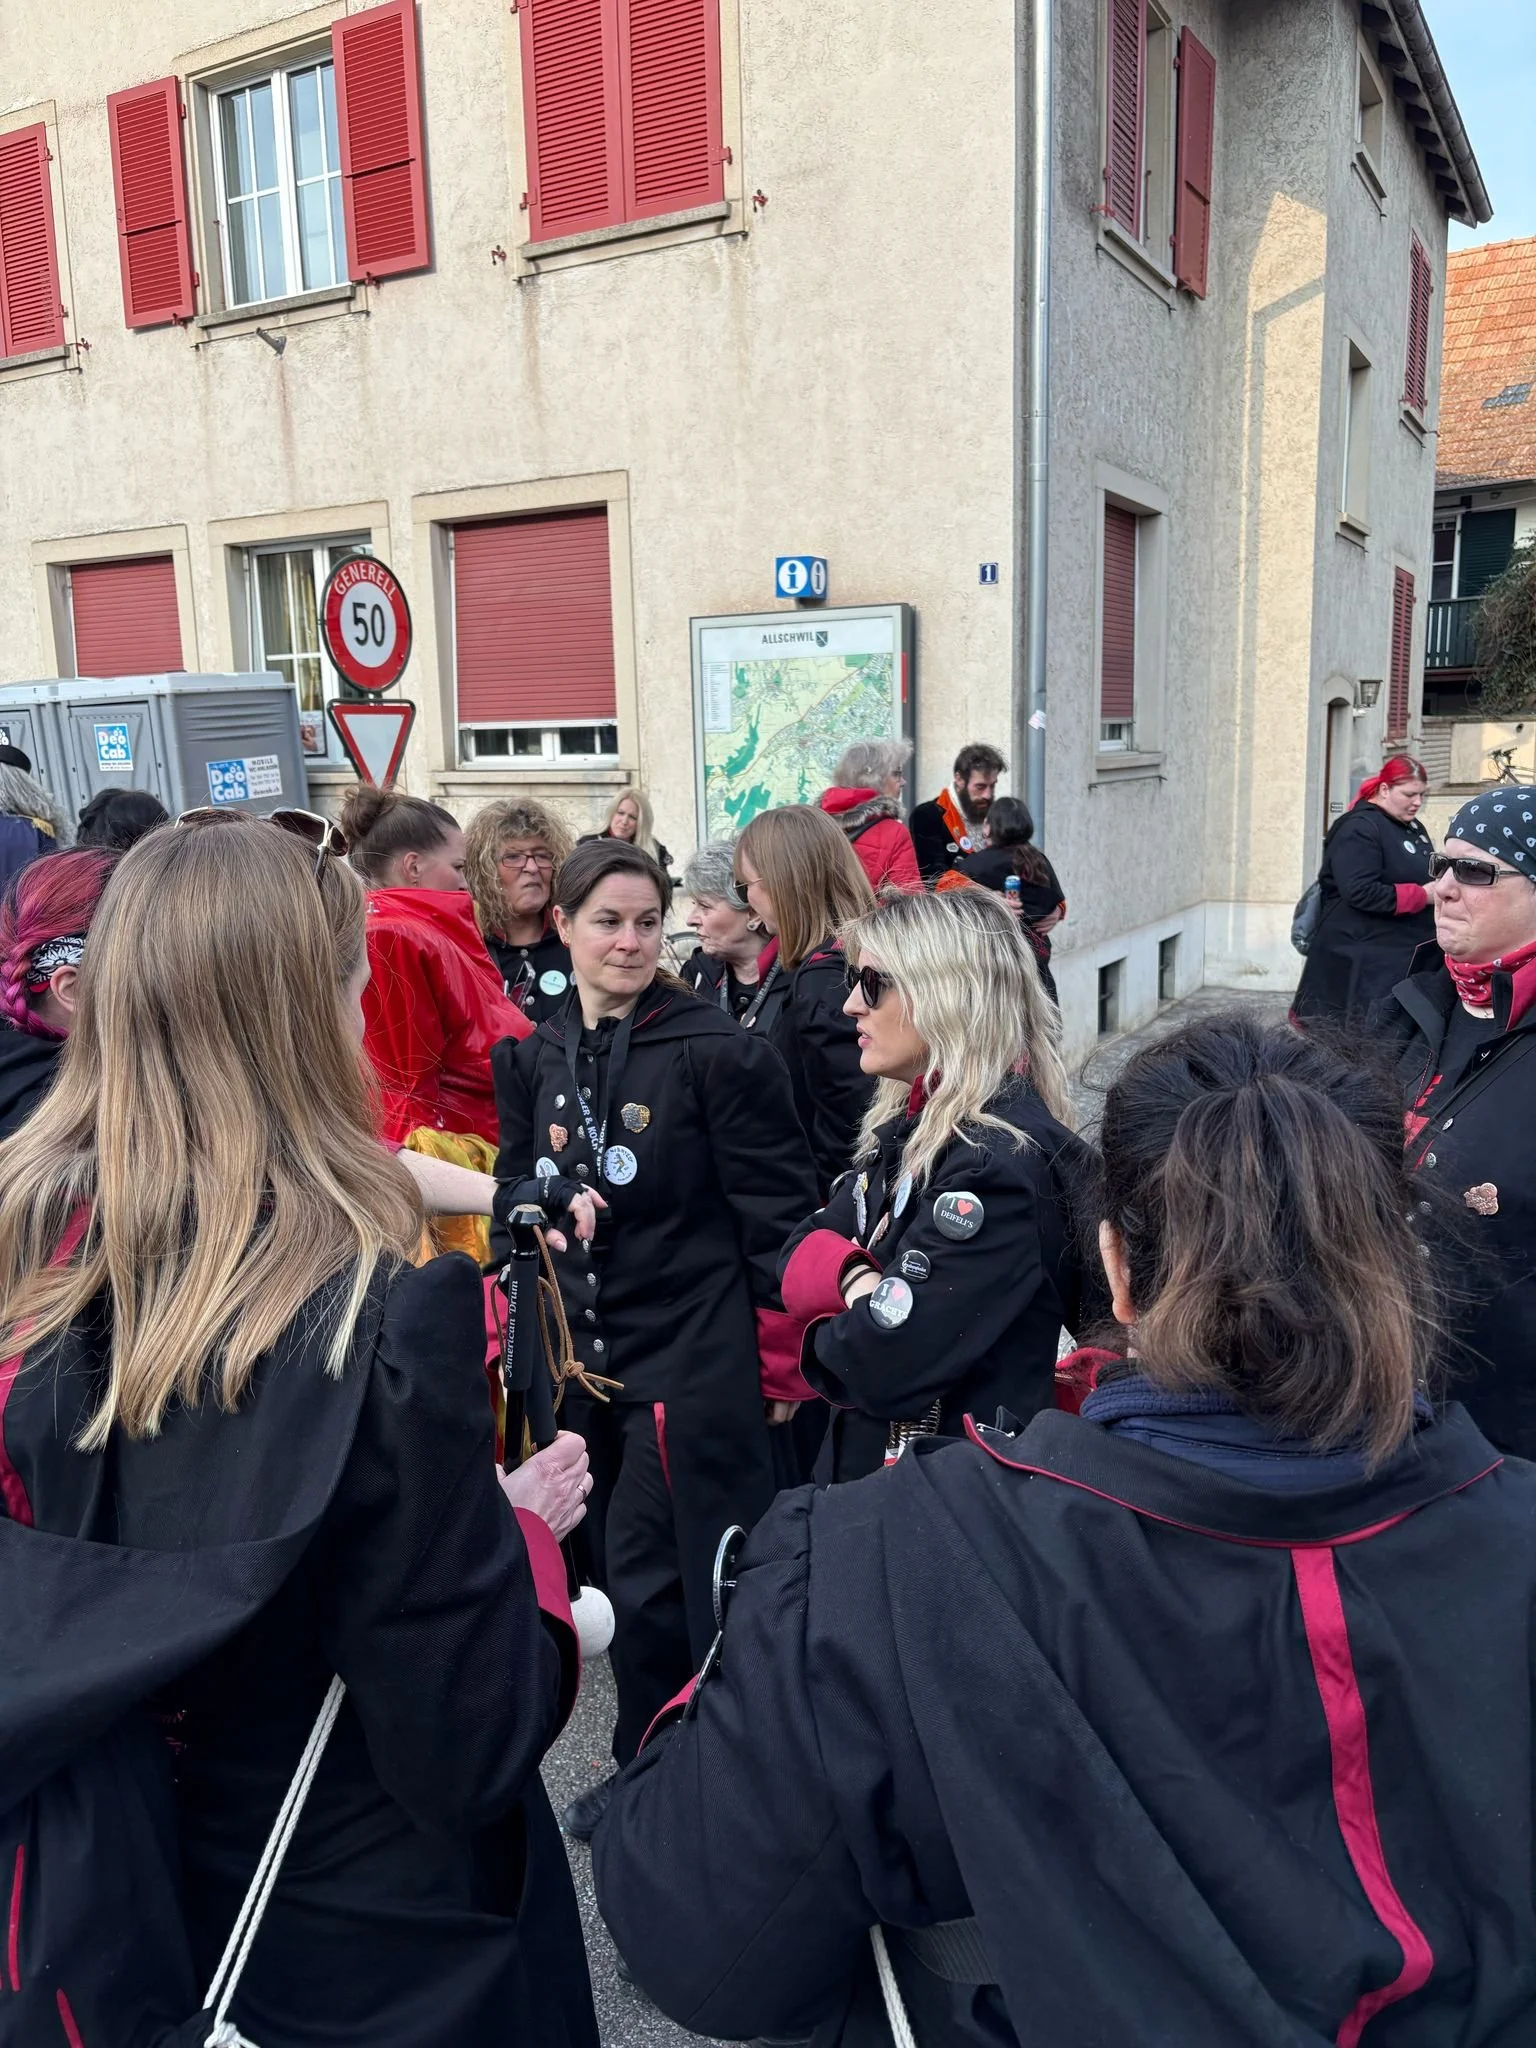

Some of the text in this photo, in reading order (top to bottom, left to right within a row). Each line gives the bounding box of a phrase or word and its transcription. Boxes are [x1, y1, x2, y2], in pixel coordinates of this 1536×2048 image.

[334, 563, 397, 600] GENERELL
[352, 602, 385, 648] 50
[762, 632, 815, 644] ALLSCHWIL
[98, 731, 126, 745] Deo
[100, 744, 126, 759] Cab
[210, 769, 246, 786] Deo
[213, 782, 246, 801] Cab
[584, 1117, 593, 1125] &
[946, 1196, 956, 1210] I
[940, 1209, 974, 1229] DEIFELI'S
[880, 1283, 888, 1297] I
[504, 1280, 519, 1378] American Drum
